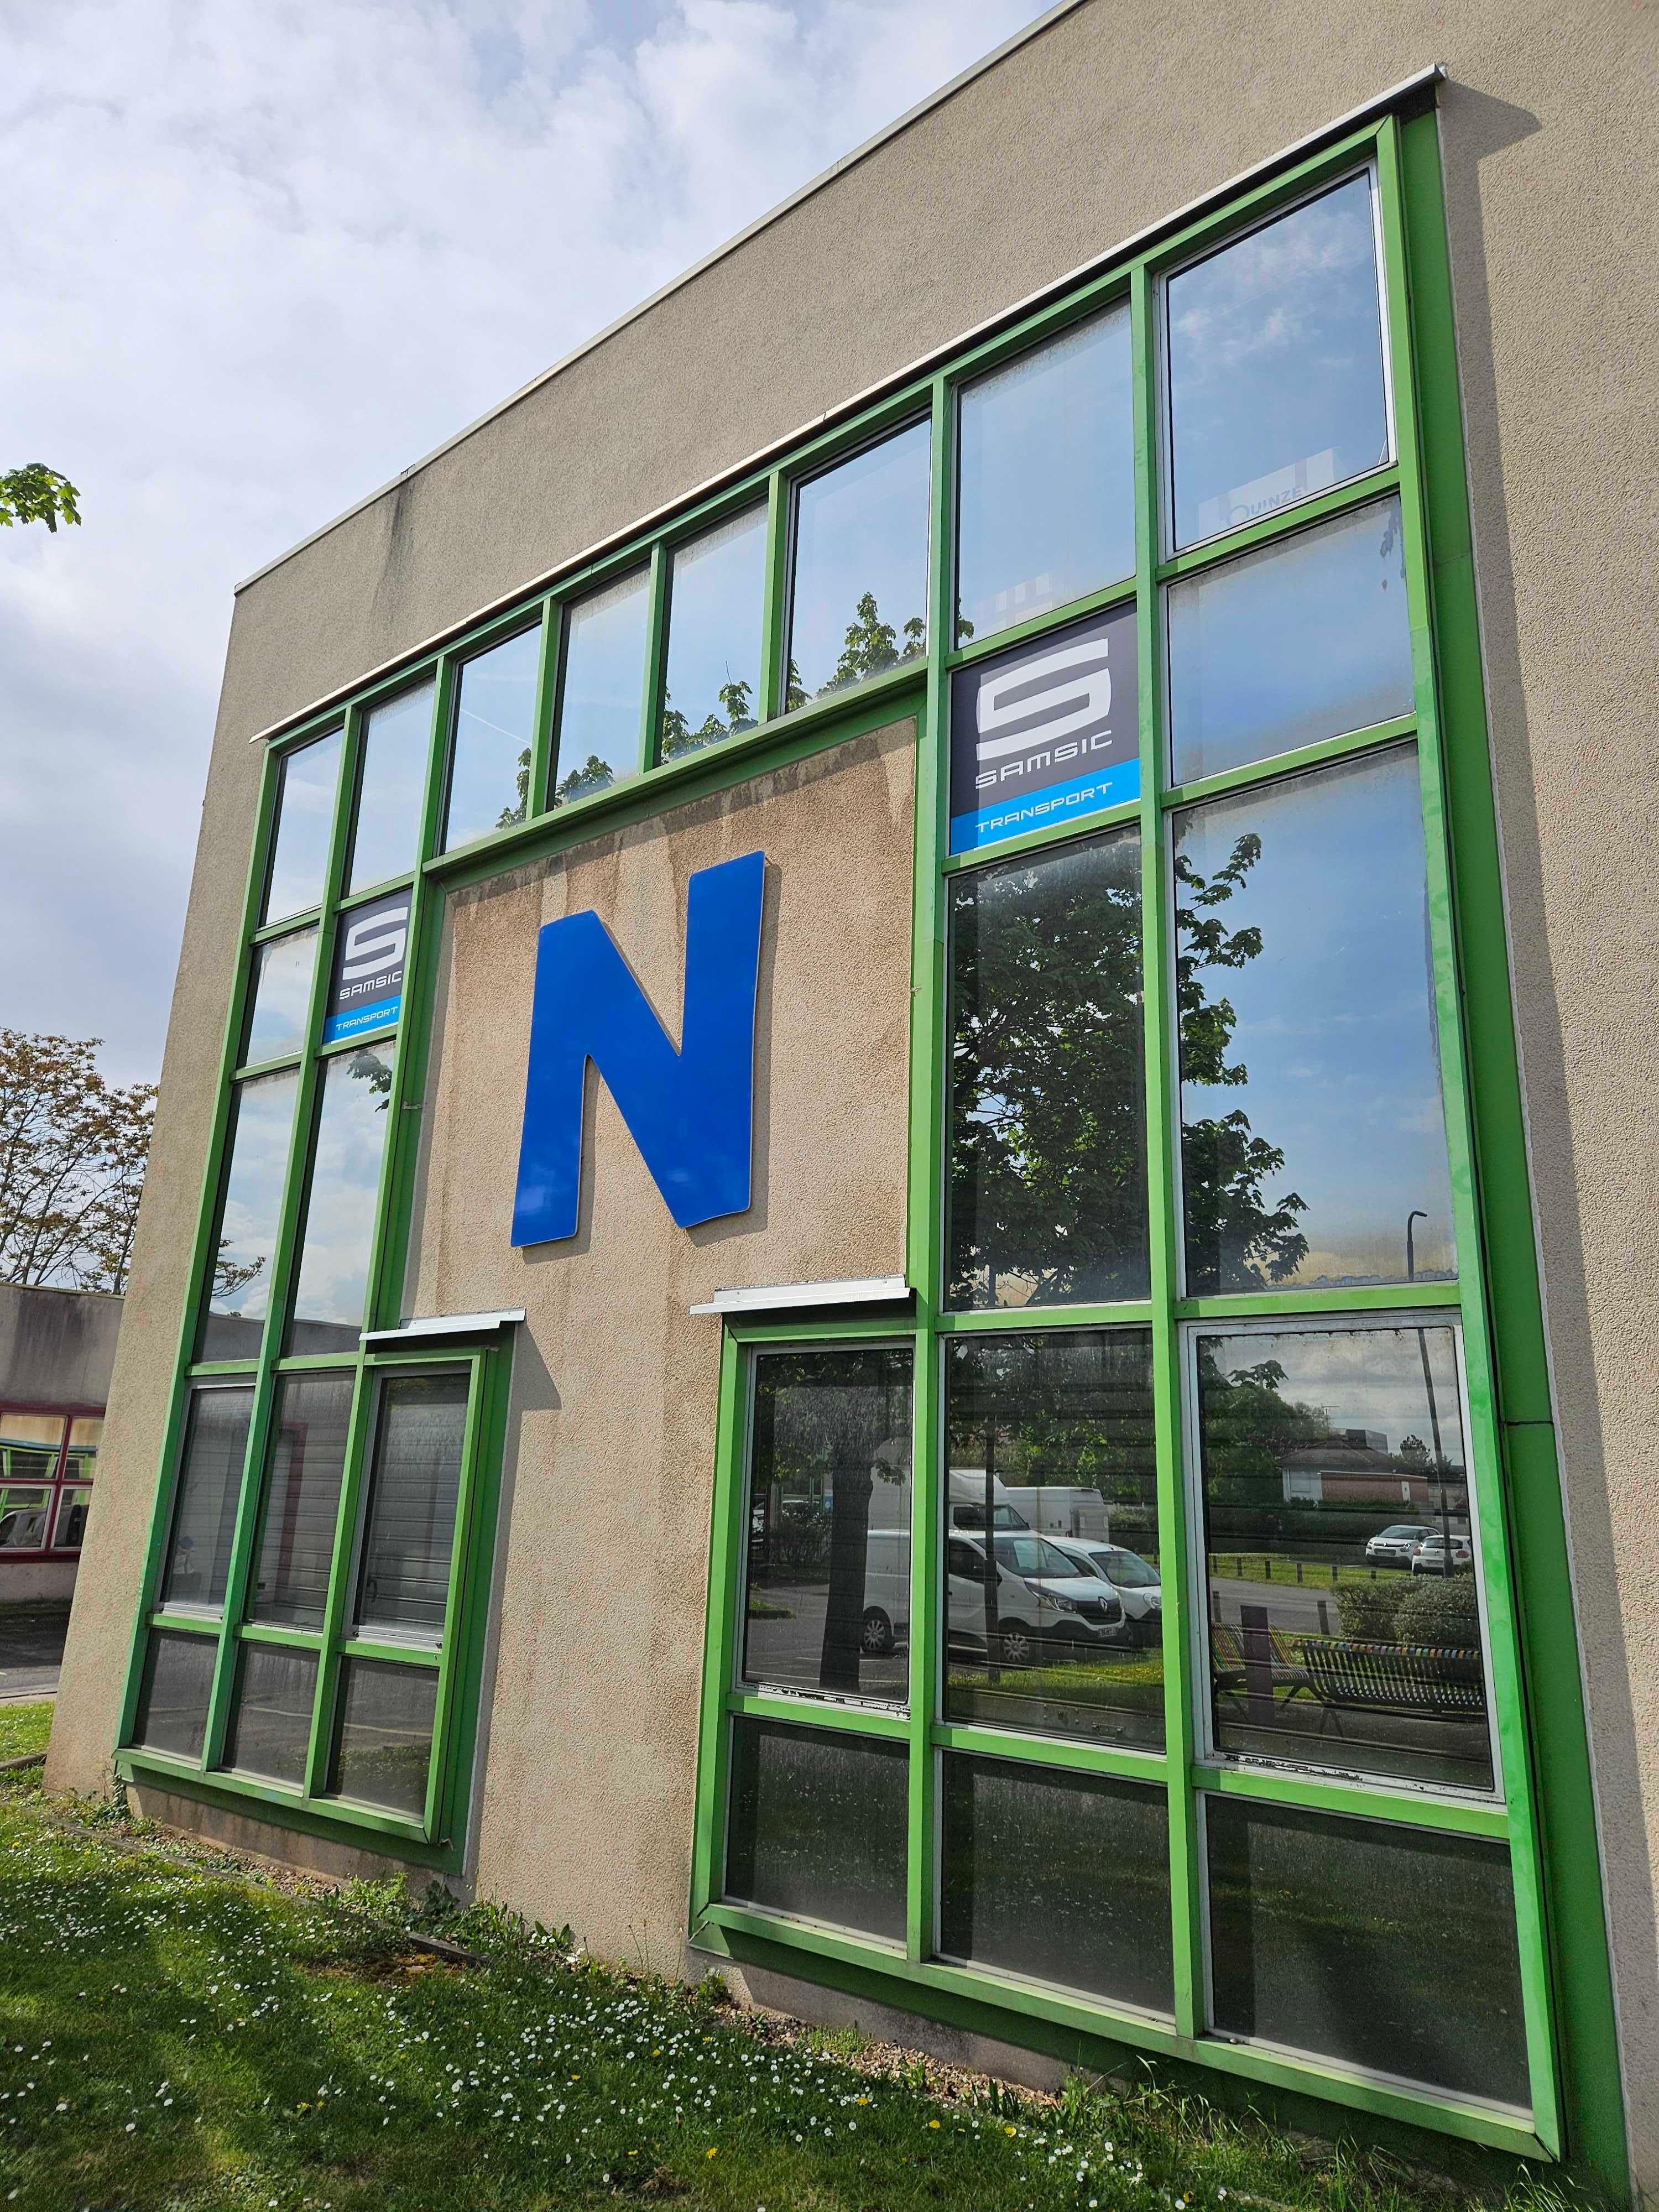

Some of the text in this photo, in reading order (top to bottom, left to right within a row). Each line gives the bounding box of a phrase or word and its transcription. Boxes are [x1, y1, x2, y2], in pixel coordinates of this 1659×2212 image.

[975, 729, 1113, 789] SAMSIC
[975, 781, 1113, 833] TRANSPORT
[339, 971, 402, 1000] SAMSIC
[336, 1006, 398, 1031] TRANSPORT
[510, 850, 765, 1248] N
